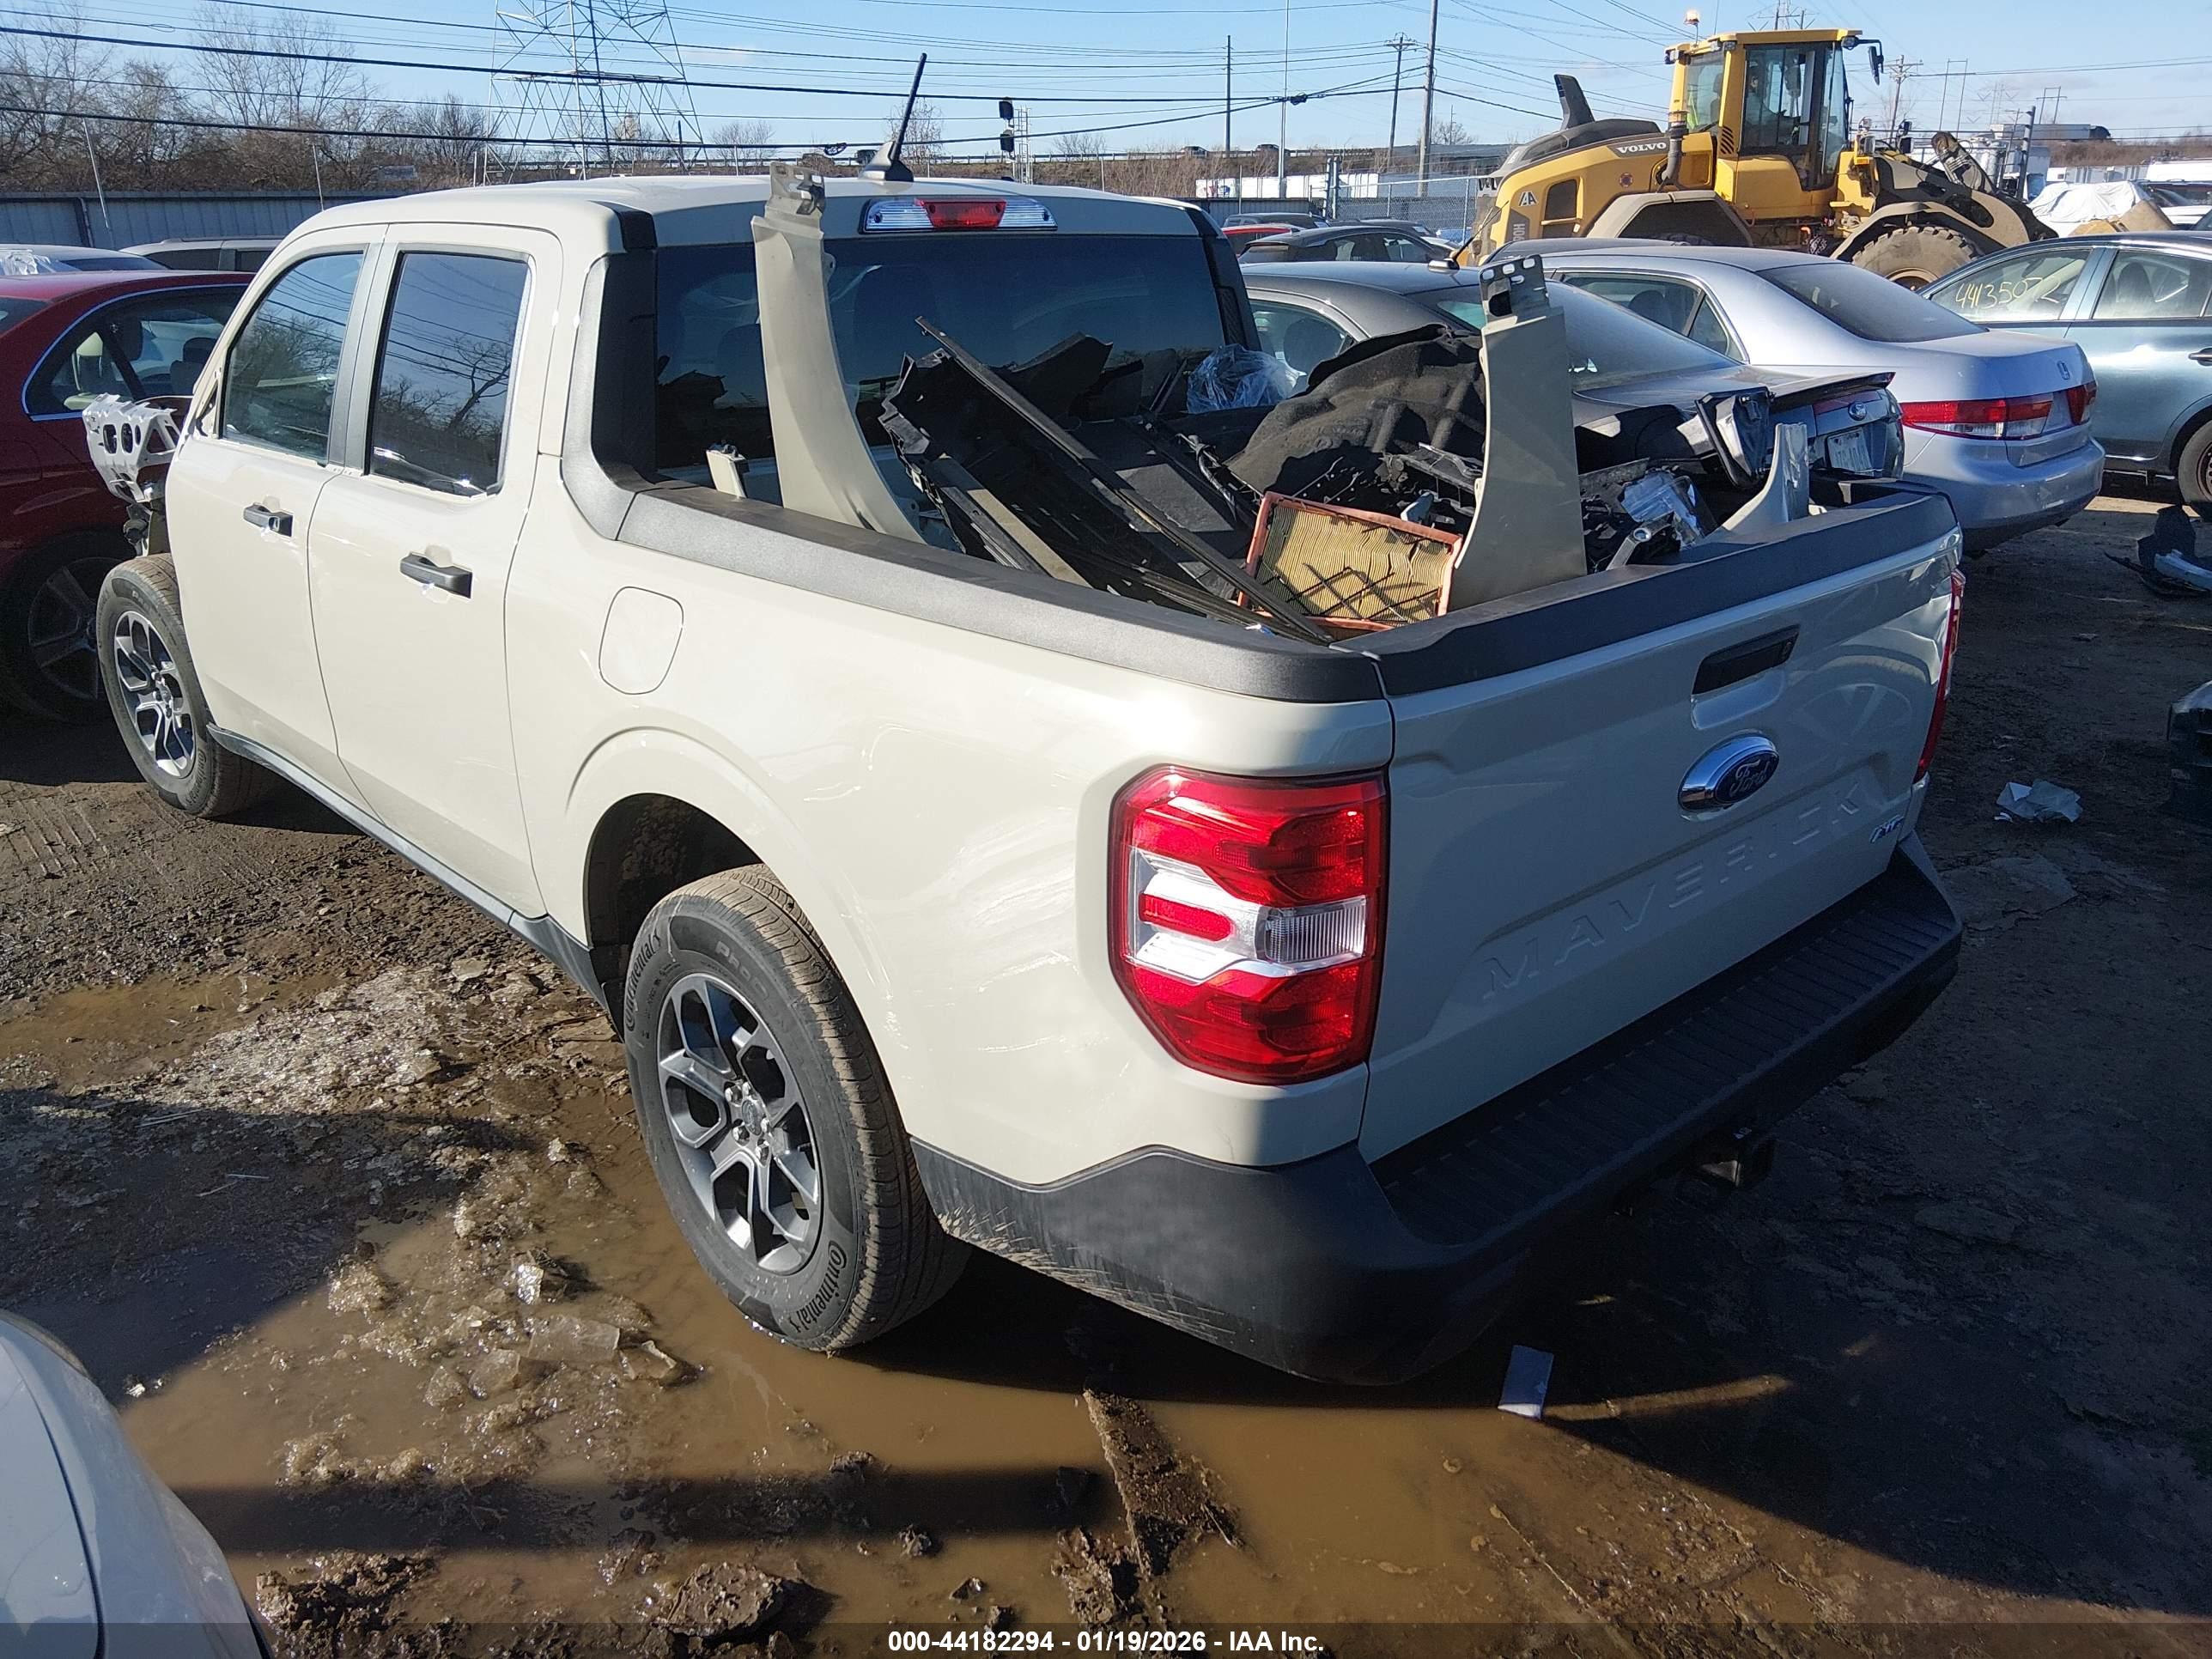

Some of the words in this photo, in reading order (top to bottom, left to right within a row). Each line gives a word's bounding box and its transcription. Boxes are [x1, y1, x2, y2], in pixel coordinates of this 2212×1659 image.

[1616, 142, 1667, 154] VOLVO
[1729, 759, 1771, 795] Ford
[1480, 782, 1862, 1002] MAVERICK
[796, 1240, 848, 1331] Continental
